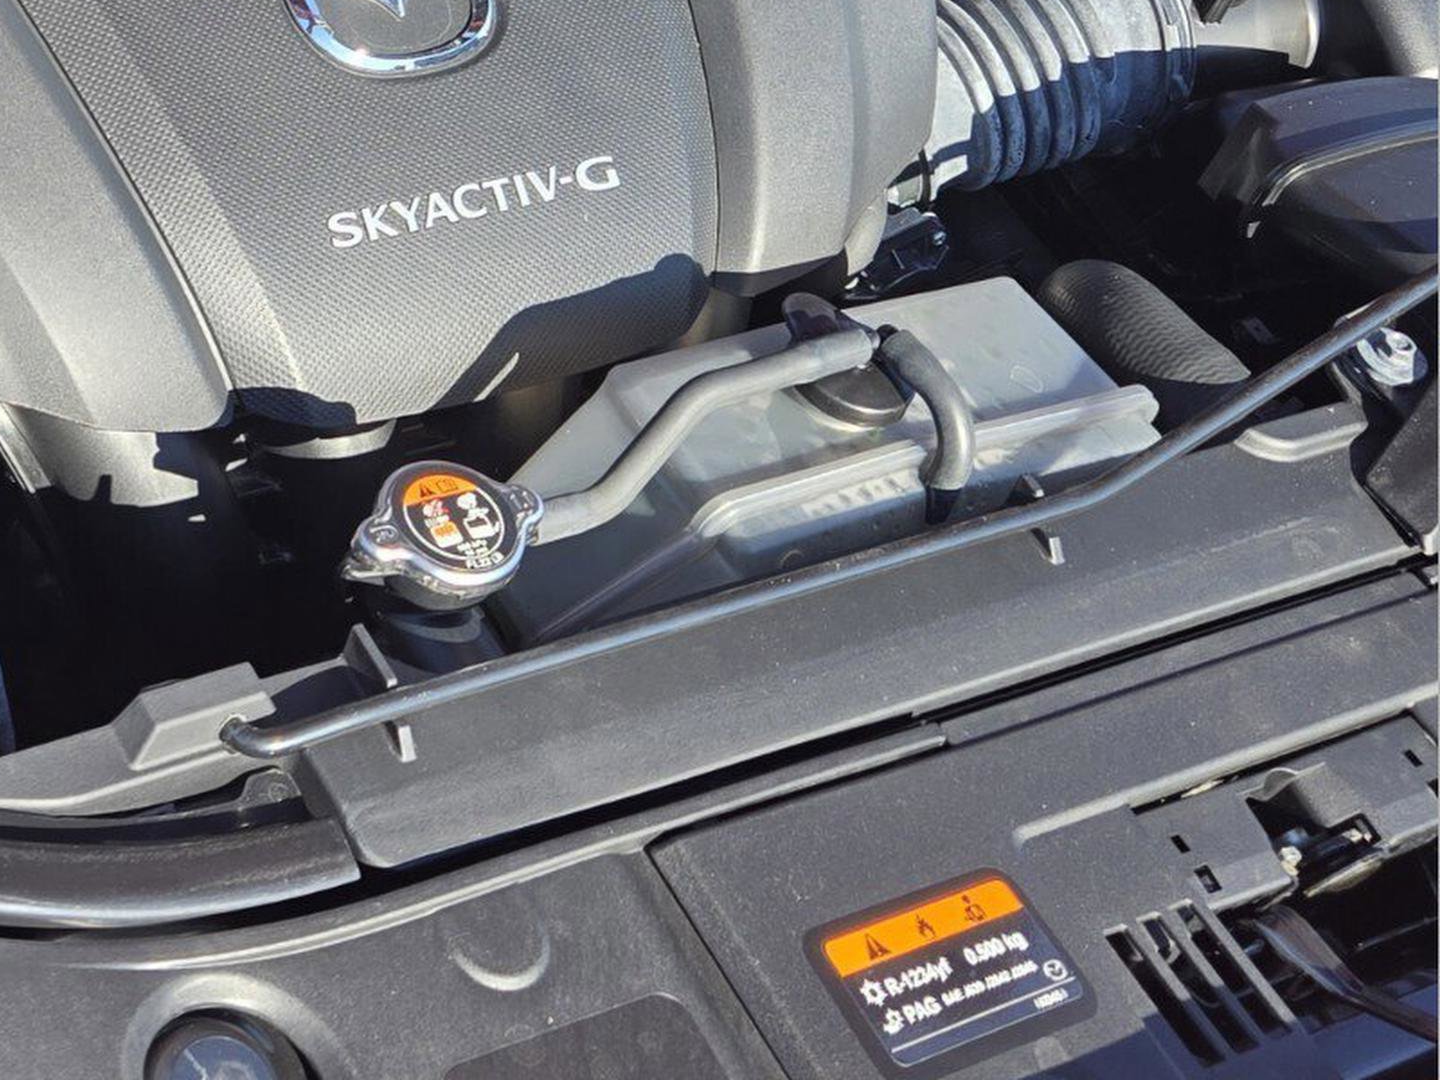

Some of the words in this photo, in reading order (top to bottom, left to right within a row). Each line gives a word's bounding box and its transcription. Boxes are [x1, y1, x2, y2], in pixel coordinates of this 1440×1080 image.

[327, 155, 621, 249] SKYACTIV-G
[1001, 931, 1029, 951] kg
[902, 995, 943, 1024] PAG
